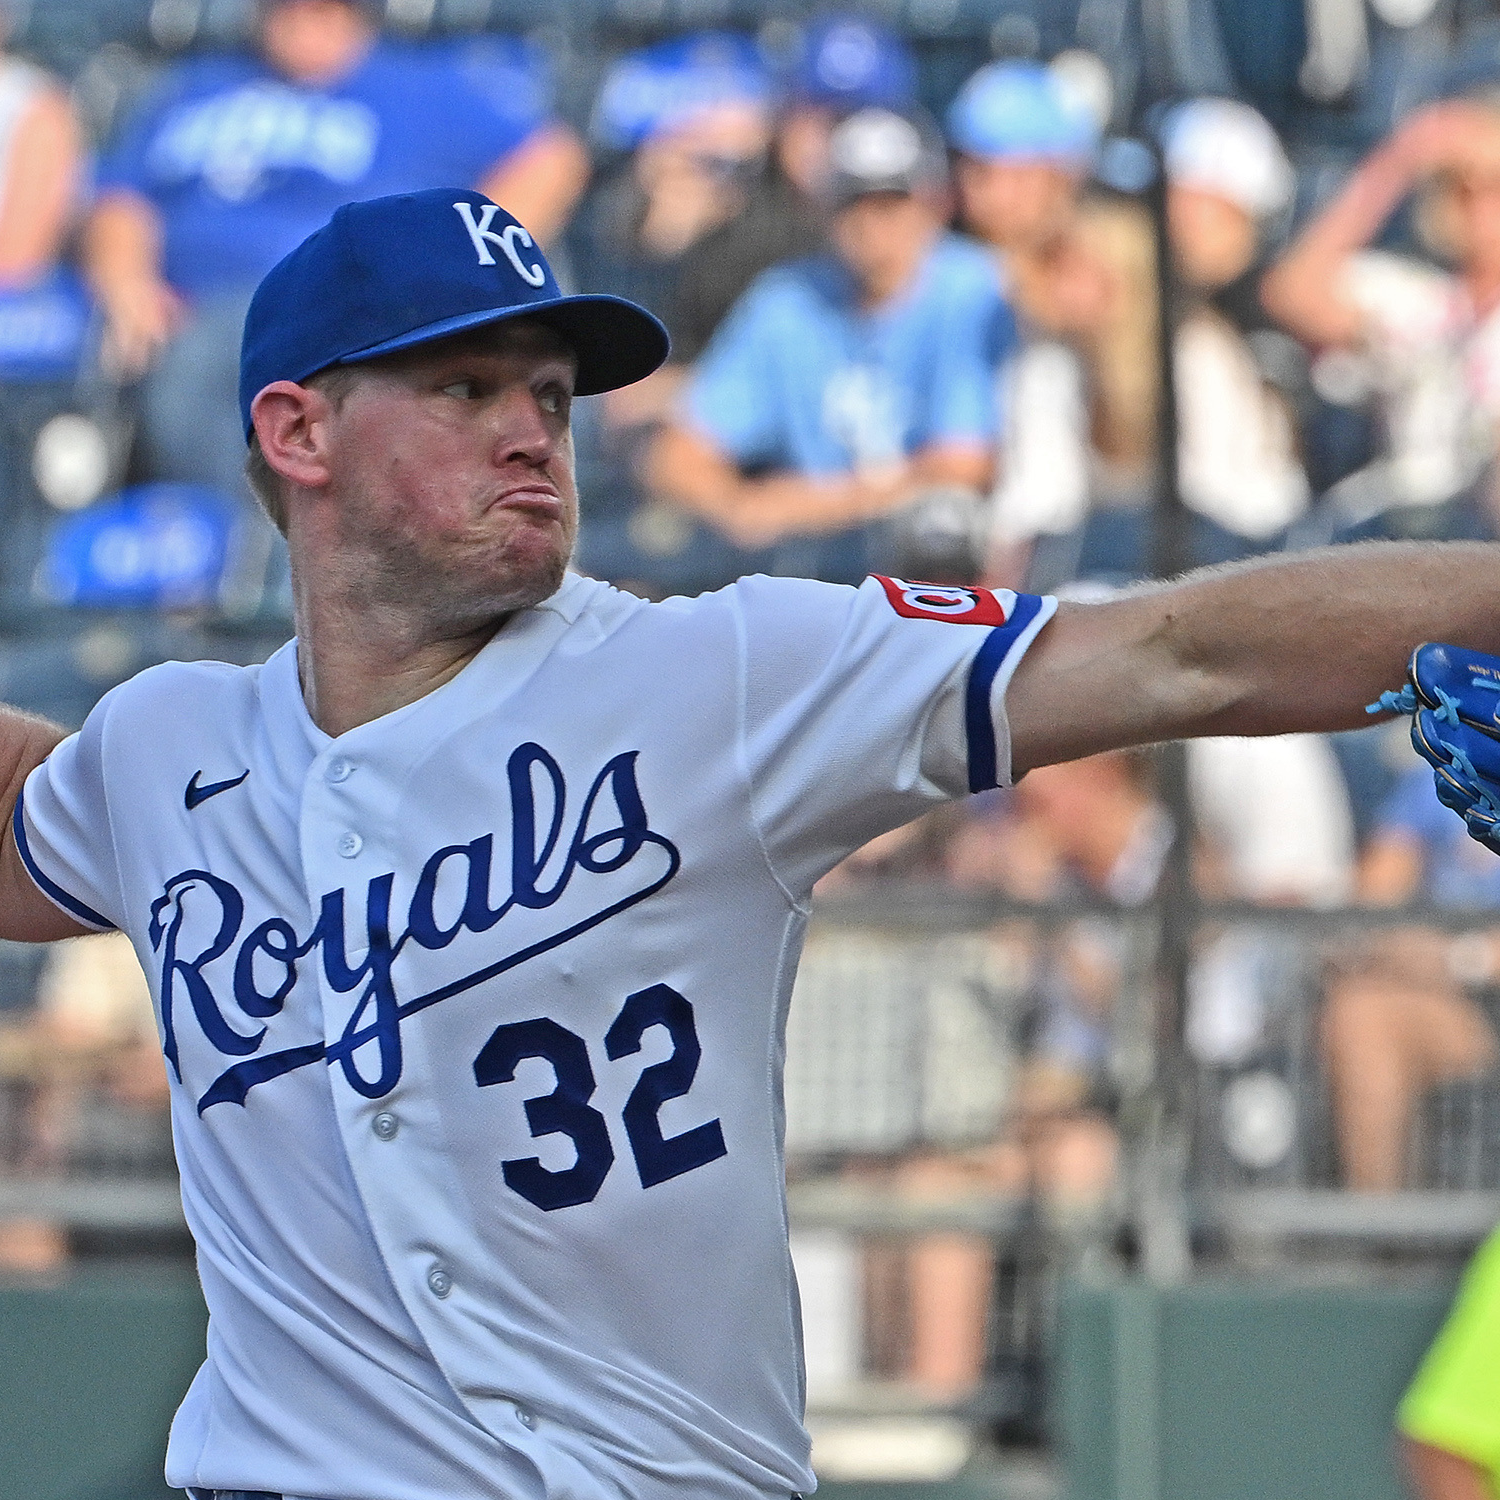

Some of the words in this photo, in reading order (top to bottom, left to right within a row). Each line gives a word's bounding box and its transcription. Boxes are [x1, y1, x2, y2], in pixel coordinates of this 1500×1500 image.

[452, 202, 546, 289] KC
[149, 742, 680, 1117] Royals
[472, 982, 728, 1213] 32
